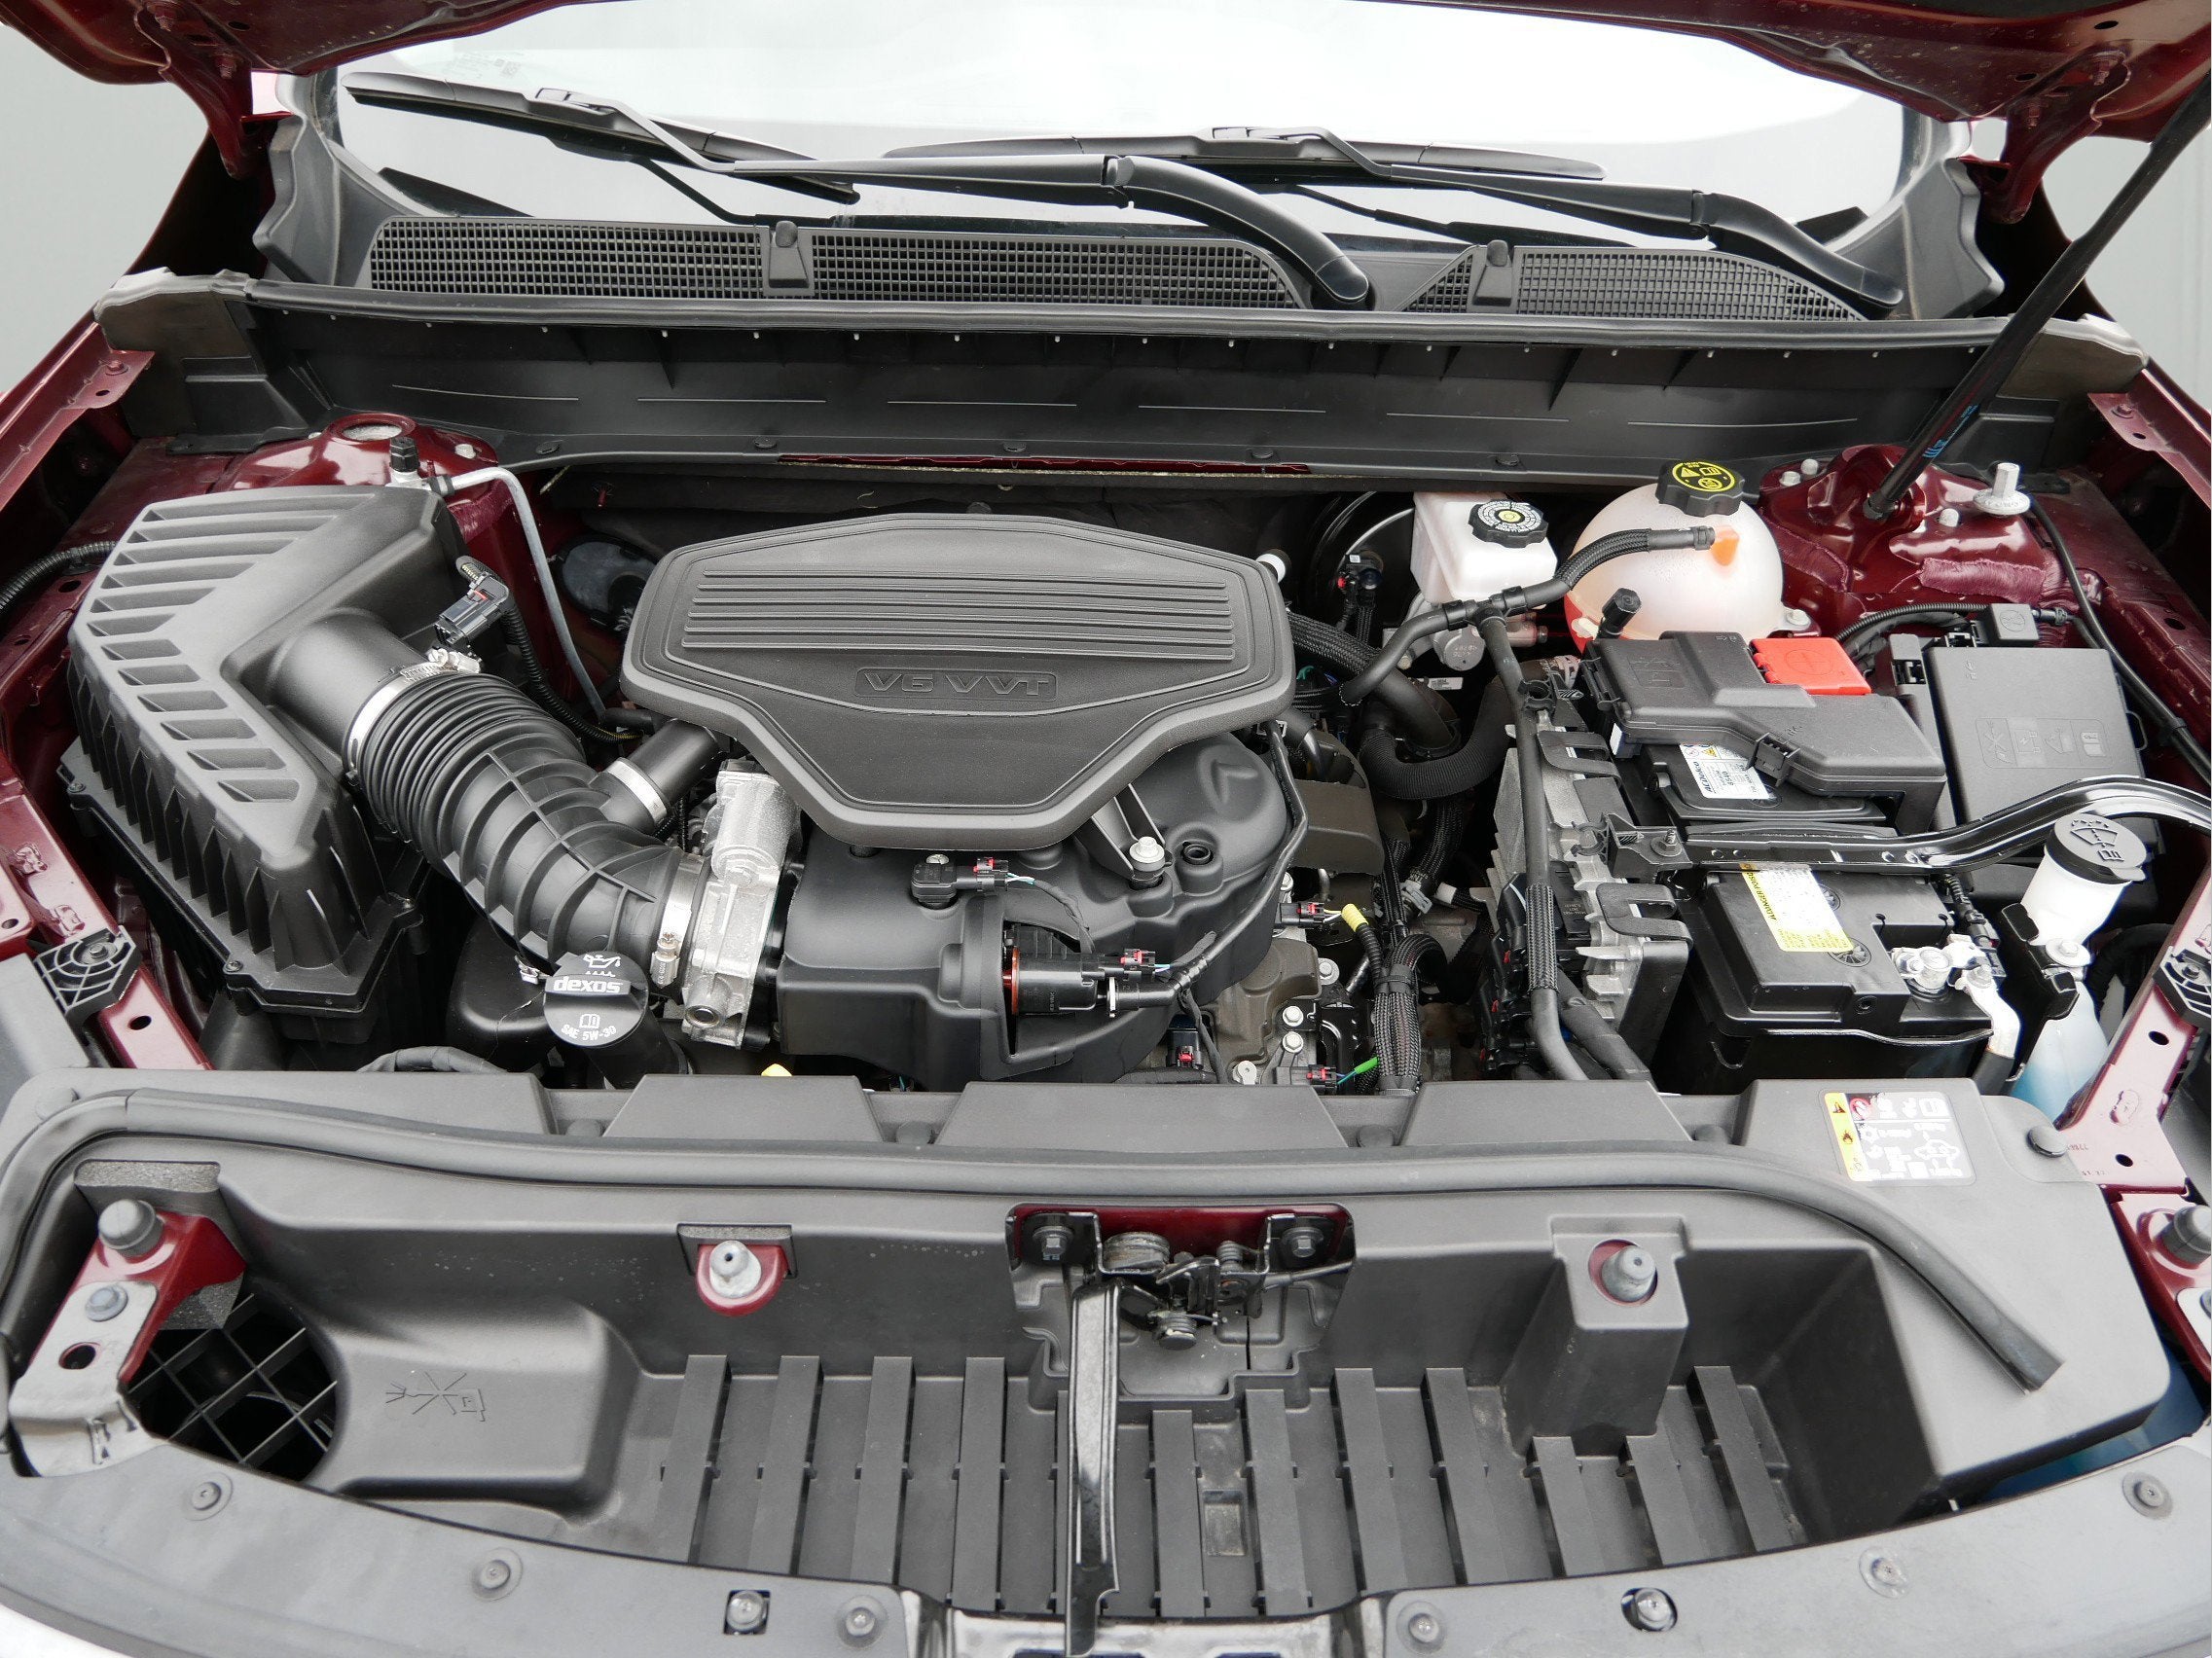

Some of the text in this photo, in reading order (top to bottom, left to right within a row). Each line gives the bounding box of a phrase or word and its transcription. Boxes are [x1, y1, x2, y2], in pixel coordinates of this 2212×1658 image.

[864, 673, 1049, 696] V6 VVT
[553, 975, 624, 993] dexos
[562, 1024, 617, 1041] SAE 5W-30
